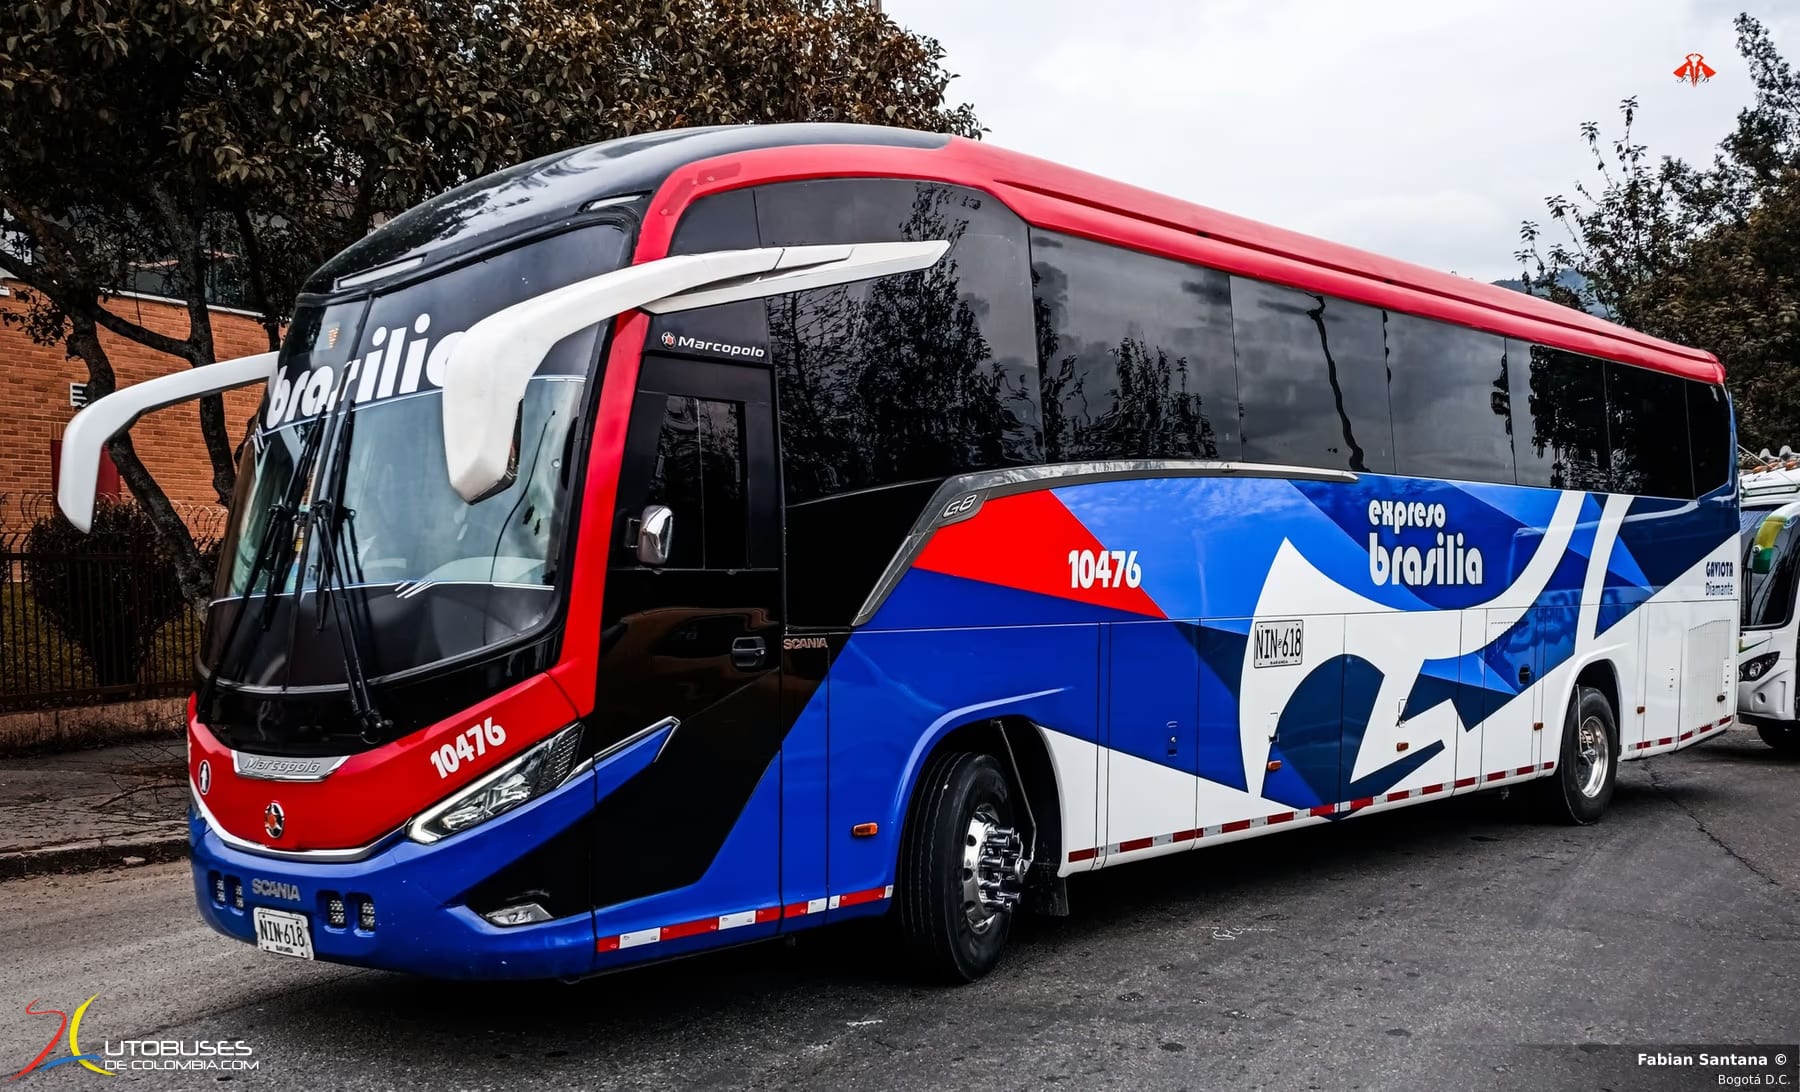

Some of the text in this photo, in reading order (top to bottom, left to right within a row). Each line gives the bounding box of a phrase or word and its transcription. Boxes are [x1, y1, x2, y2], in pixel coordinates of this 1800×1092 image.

[678, 336, 765, 358] Marcopolo
[943, 494, 977, 518] G8
[1368, 499, 1446, 535] expreso
[1068, 549, 1142, 590] 10476
[1369, 532, 1483, 586] brasilia
[783, 637, 829, 650] SCANIA
[430, 716, 507, 779] 10476
[245, 757, 321, 775] Marcopolo
[252, 878, 301, 902] SCANIA
